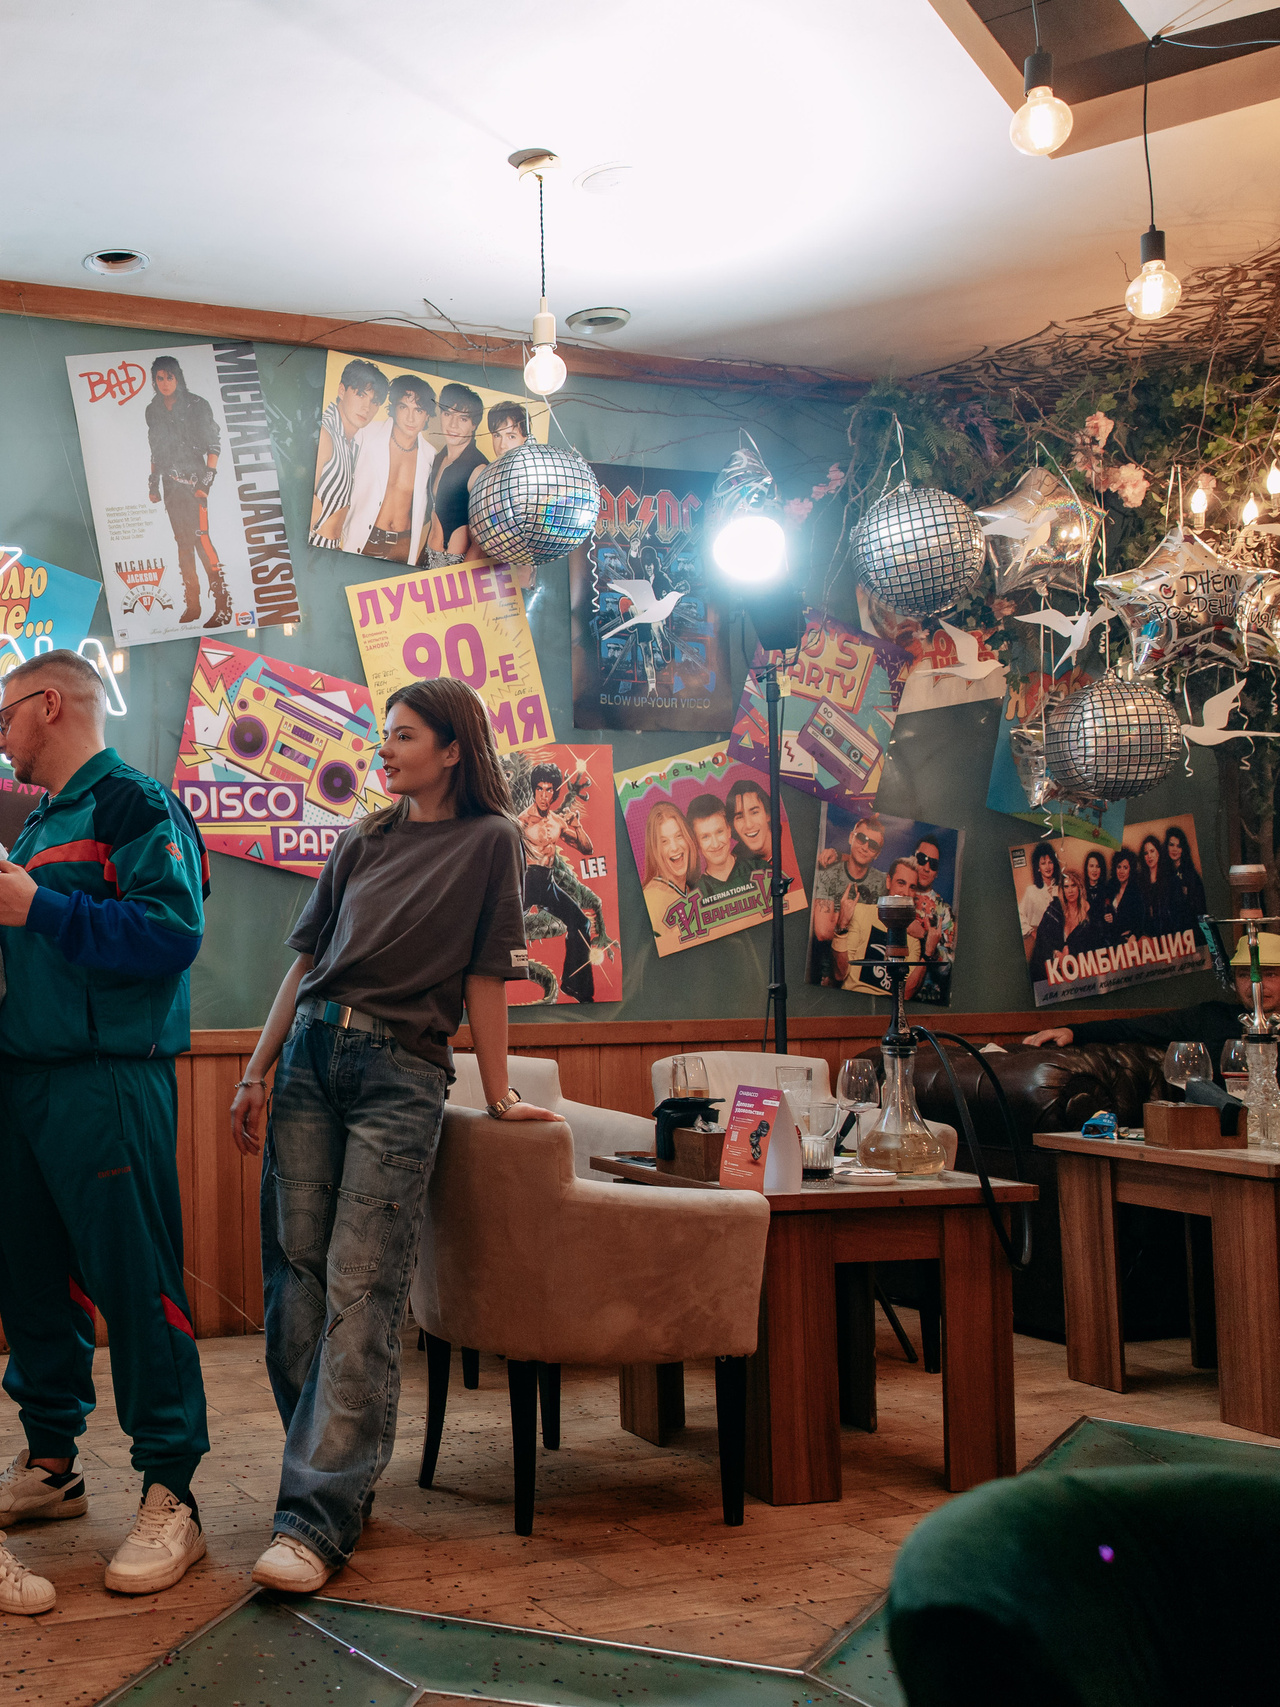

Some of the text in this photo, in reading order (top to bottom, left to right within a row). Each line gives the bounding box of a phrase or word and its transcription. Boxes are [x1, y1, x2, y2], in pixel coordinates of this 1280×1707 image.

[79, 361, 146, 406] BAD
[212, 340, 301, 627] MICHAEL JACKSON
[115, 558, 165, 573] MICHAEL
[127, 572, 159, 584] JACKSON
[357, 564, 517, 628] ЛУЧШЕЕ
[600, 693, 711, 709] BLOW UP YOUR VIDEO
[822, 706, 833, 719] 90
[184, 785, 298, 820] DISCO
[279, 827, 346, 856] PAR
[579, 855, 608, 880] LEE
[702, 883, 755, 905] INTERNATIONAL
[1045, 928, 1197, 986] КОМБИНАЦИЯ
